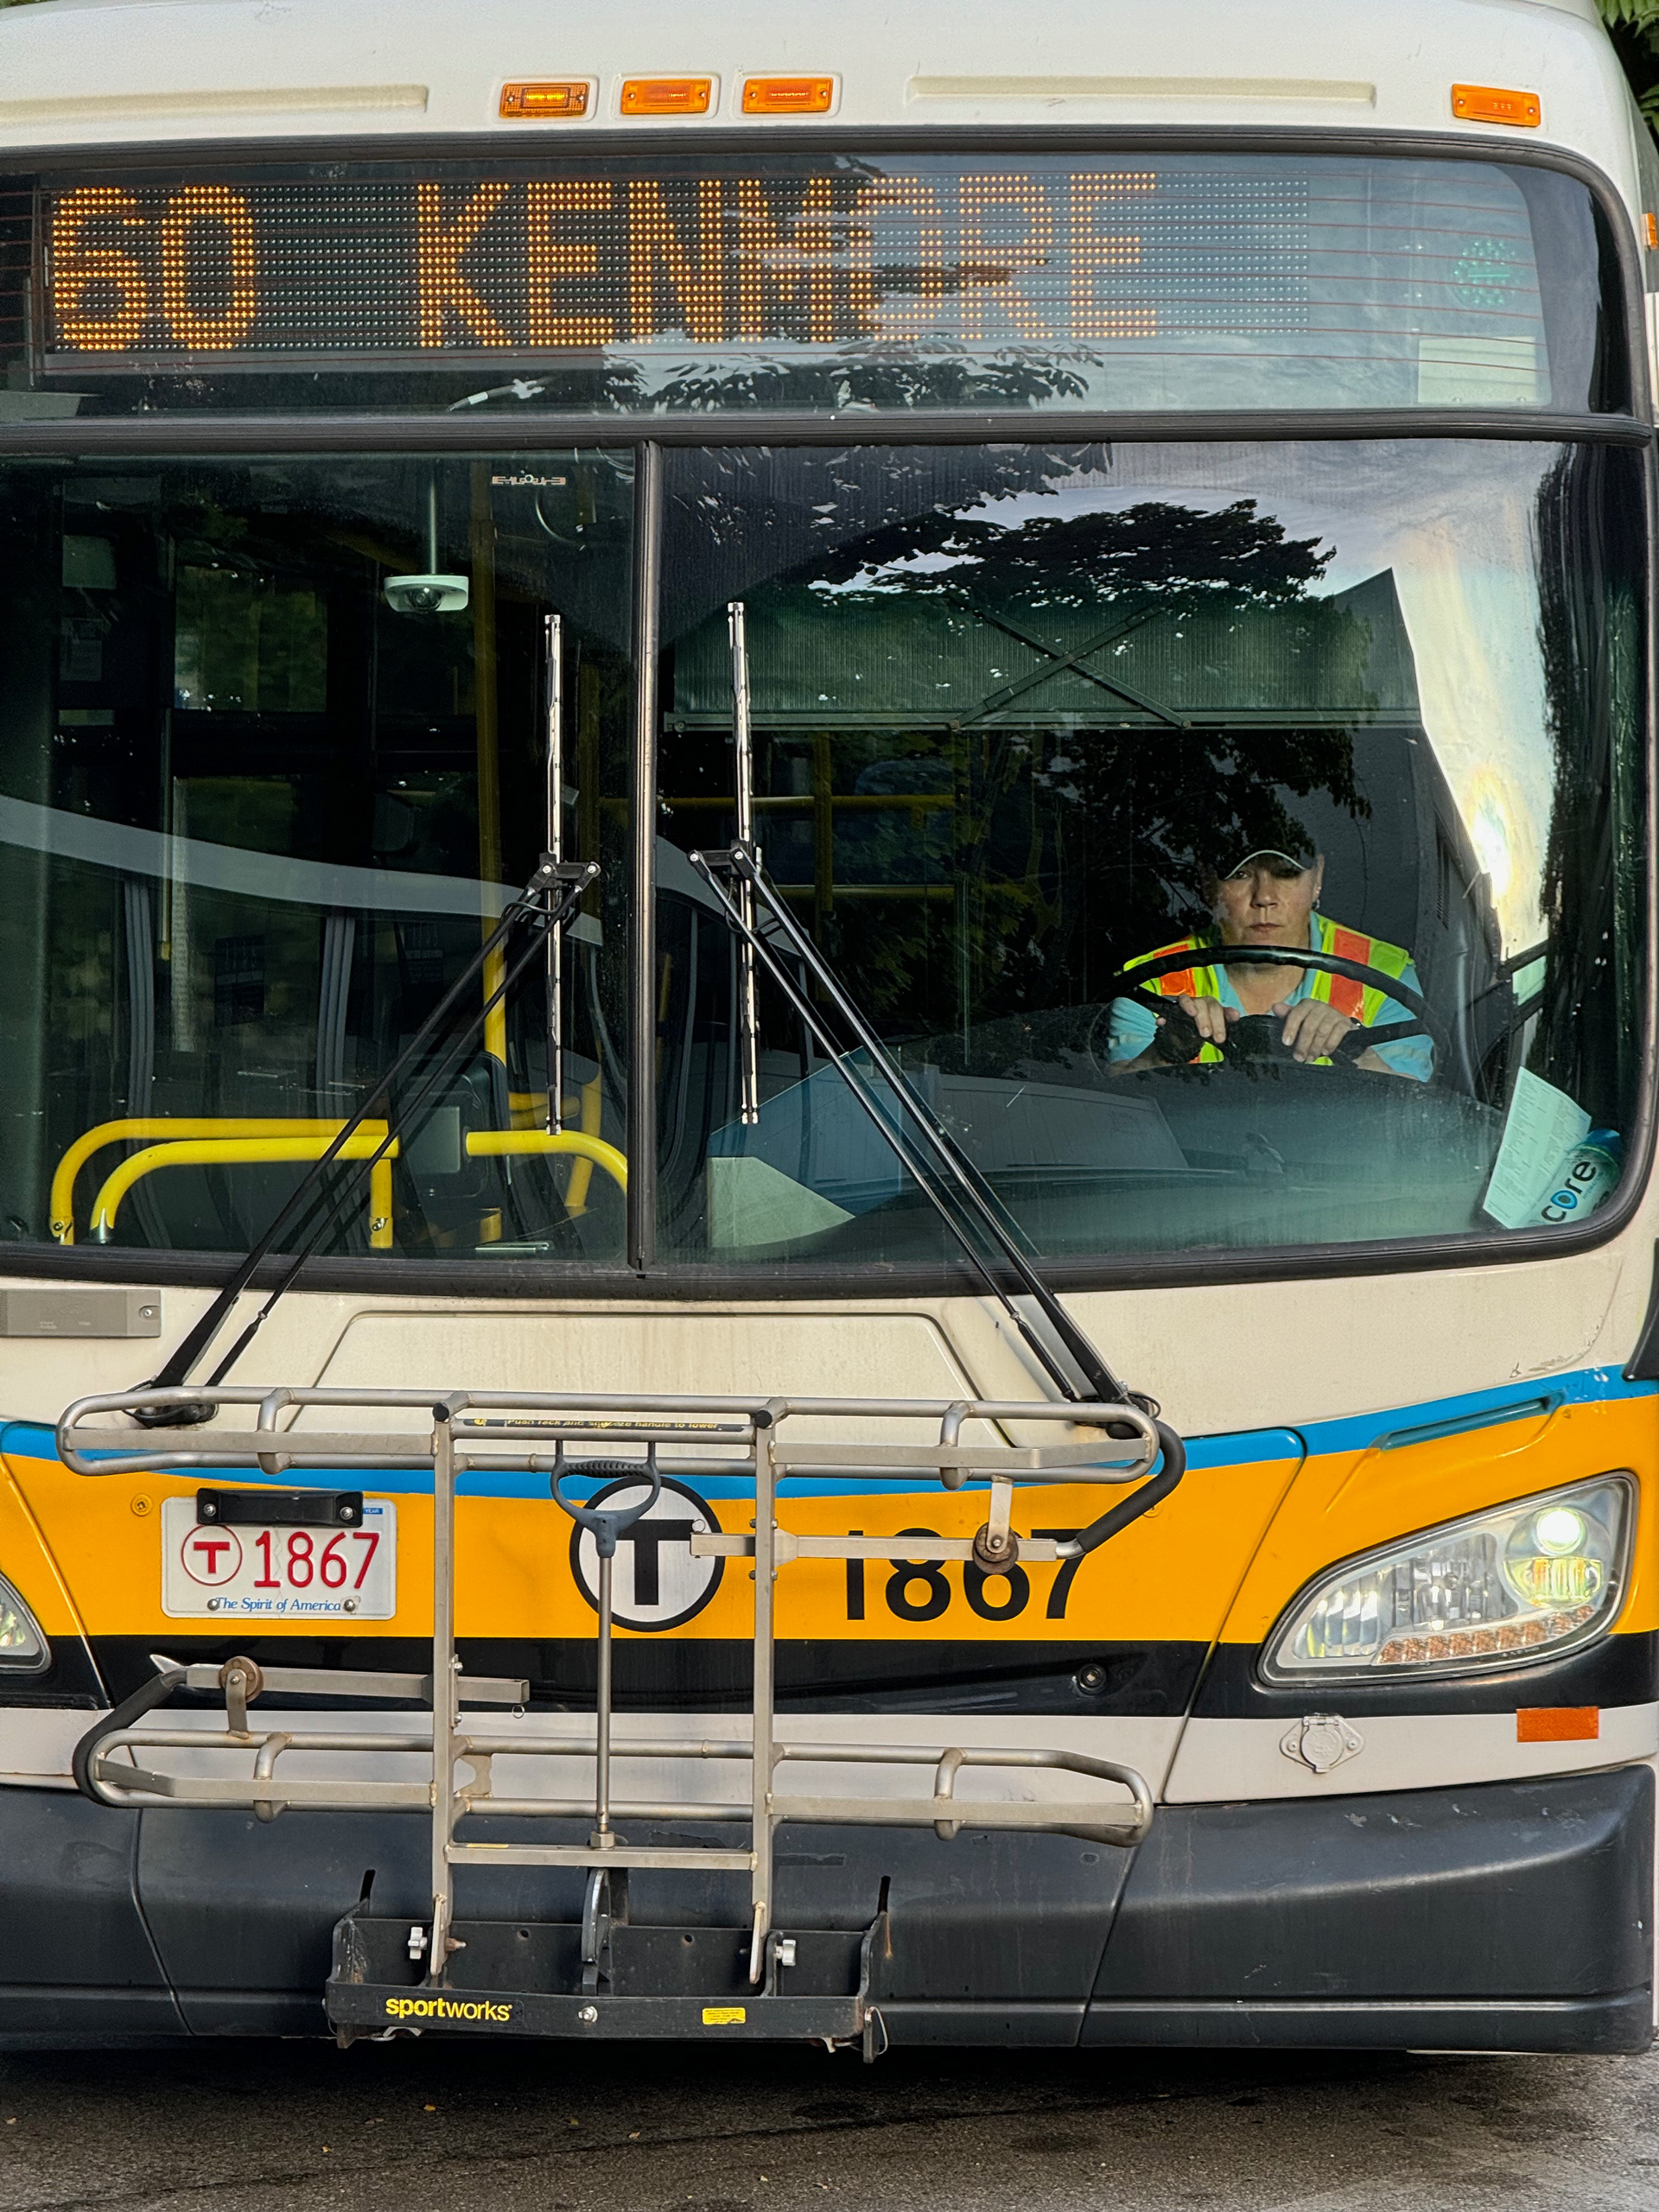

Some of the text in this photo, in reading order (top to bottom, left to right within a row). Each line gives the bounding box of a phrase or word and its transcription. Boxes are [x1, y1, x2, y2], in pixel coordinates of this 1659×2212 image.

[53, 172, 1158, 351] 60 KENMORE
[1541, 1160, 1598, 1223] core
[193, 1530, 380, 1589] T 1867
[846, 1527, 1088, 1623] 1867
[215, 1596, 342, 1613] The Spirit of America
[385, 1997, 511, 2022] sportworks
